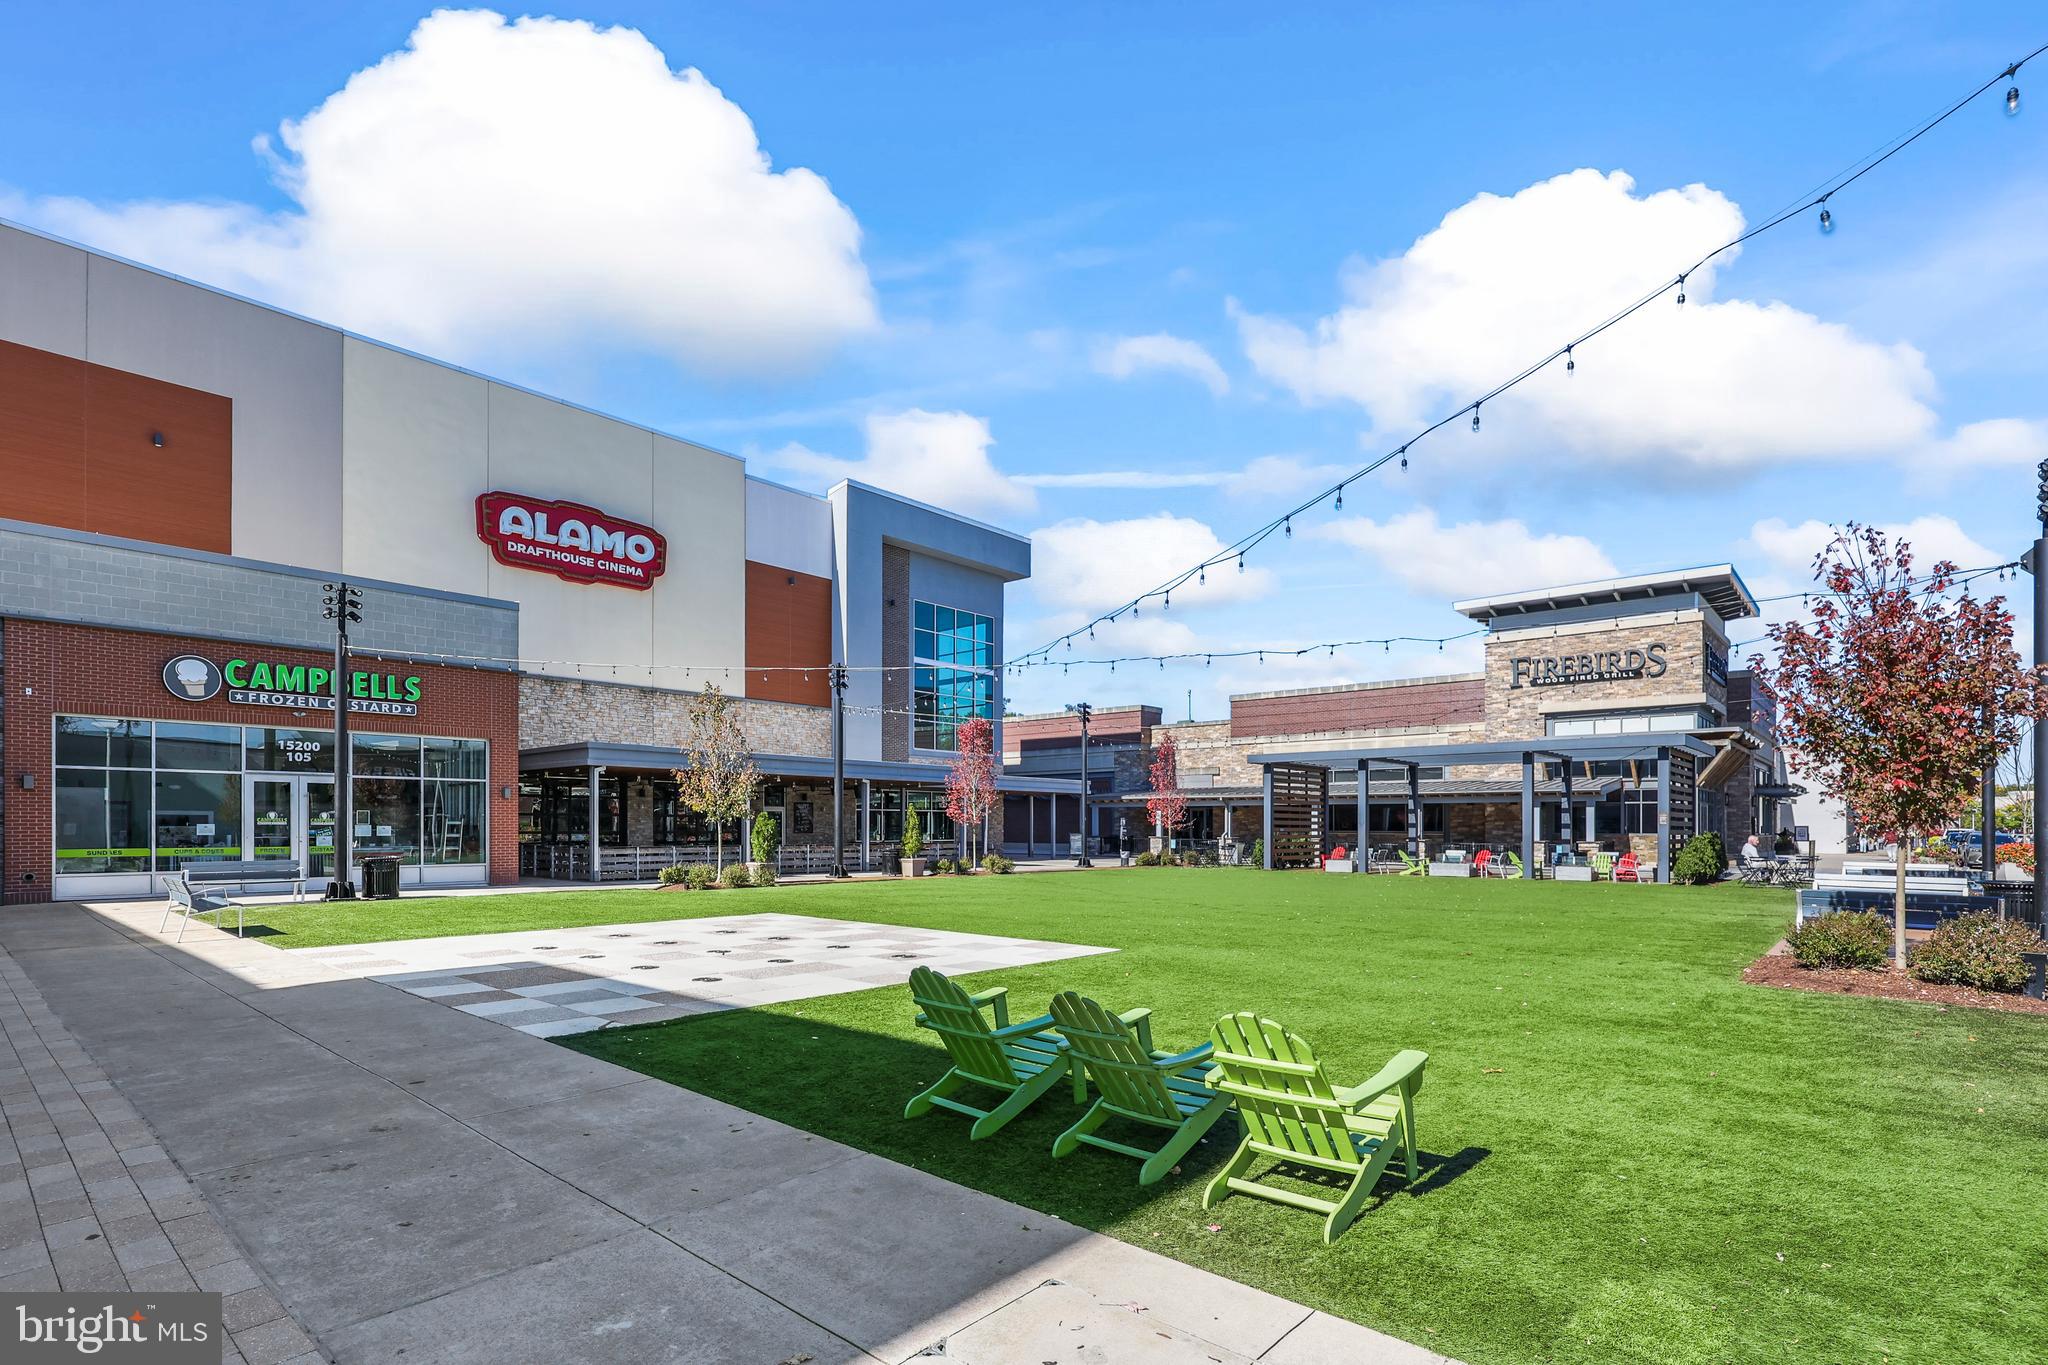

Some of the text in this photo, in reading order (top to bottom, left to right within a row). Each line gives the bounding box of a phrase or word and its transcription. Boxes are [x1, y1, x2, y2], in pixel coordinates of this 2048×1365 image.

[499, 506, 656, 564] ALAMO
[507, 541, 644, 578] DRAFTHOUSE CINEMA
[1510, 642, 1668, 690] FIREBIRDS
[1536, 671, 1635, 684] WOOD FIRED GRILL
[248, 693, 402, 713] FROZEN CSTARD
[278, 740, 321, 751] 15200
[286, 752, 312, 762] 105
